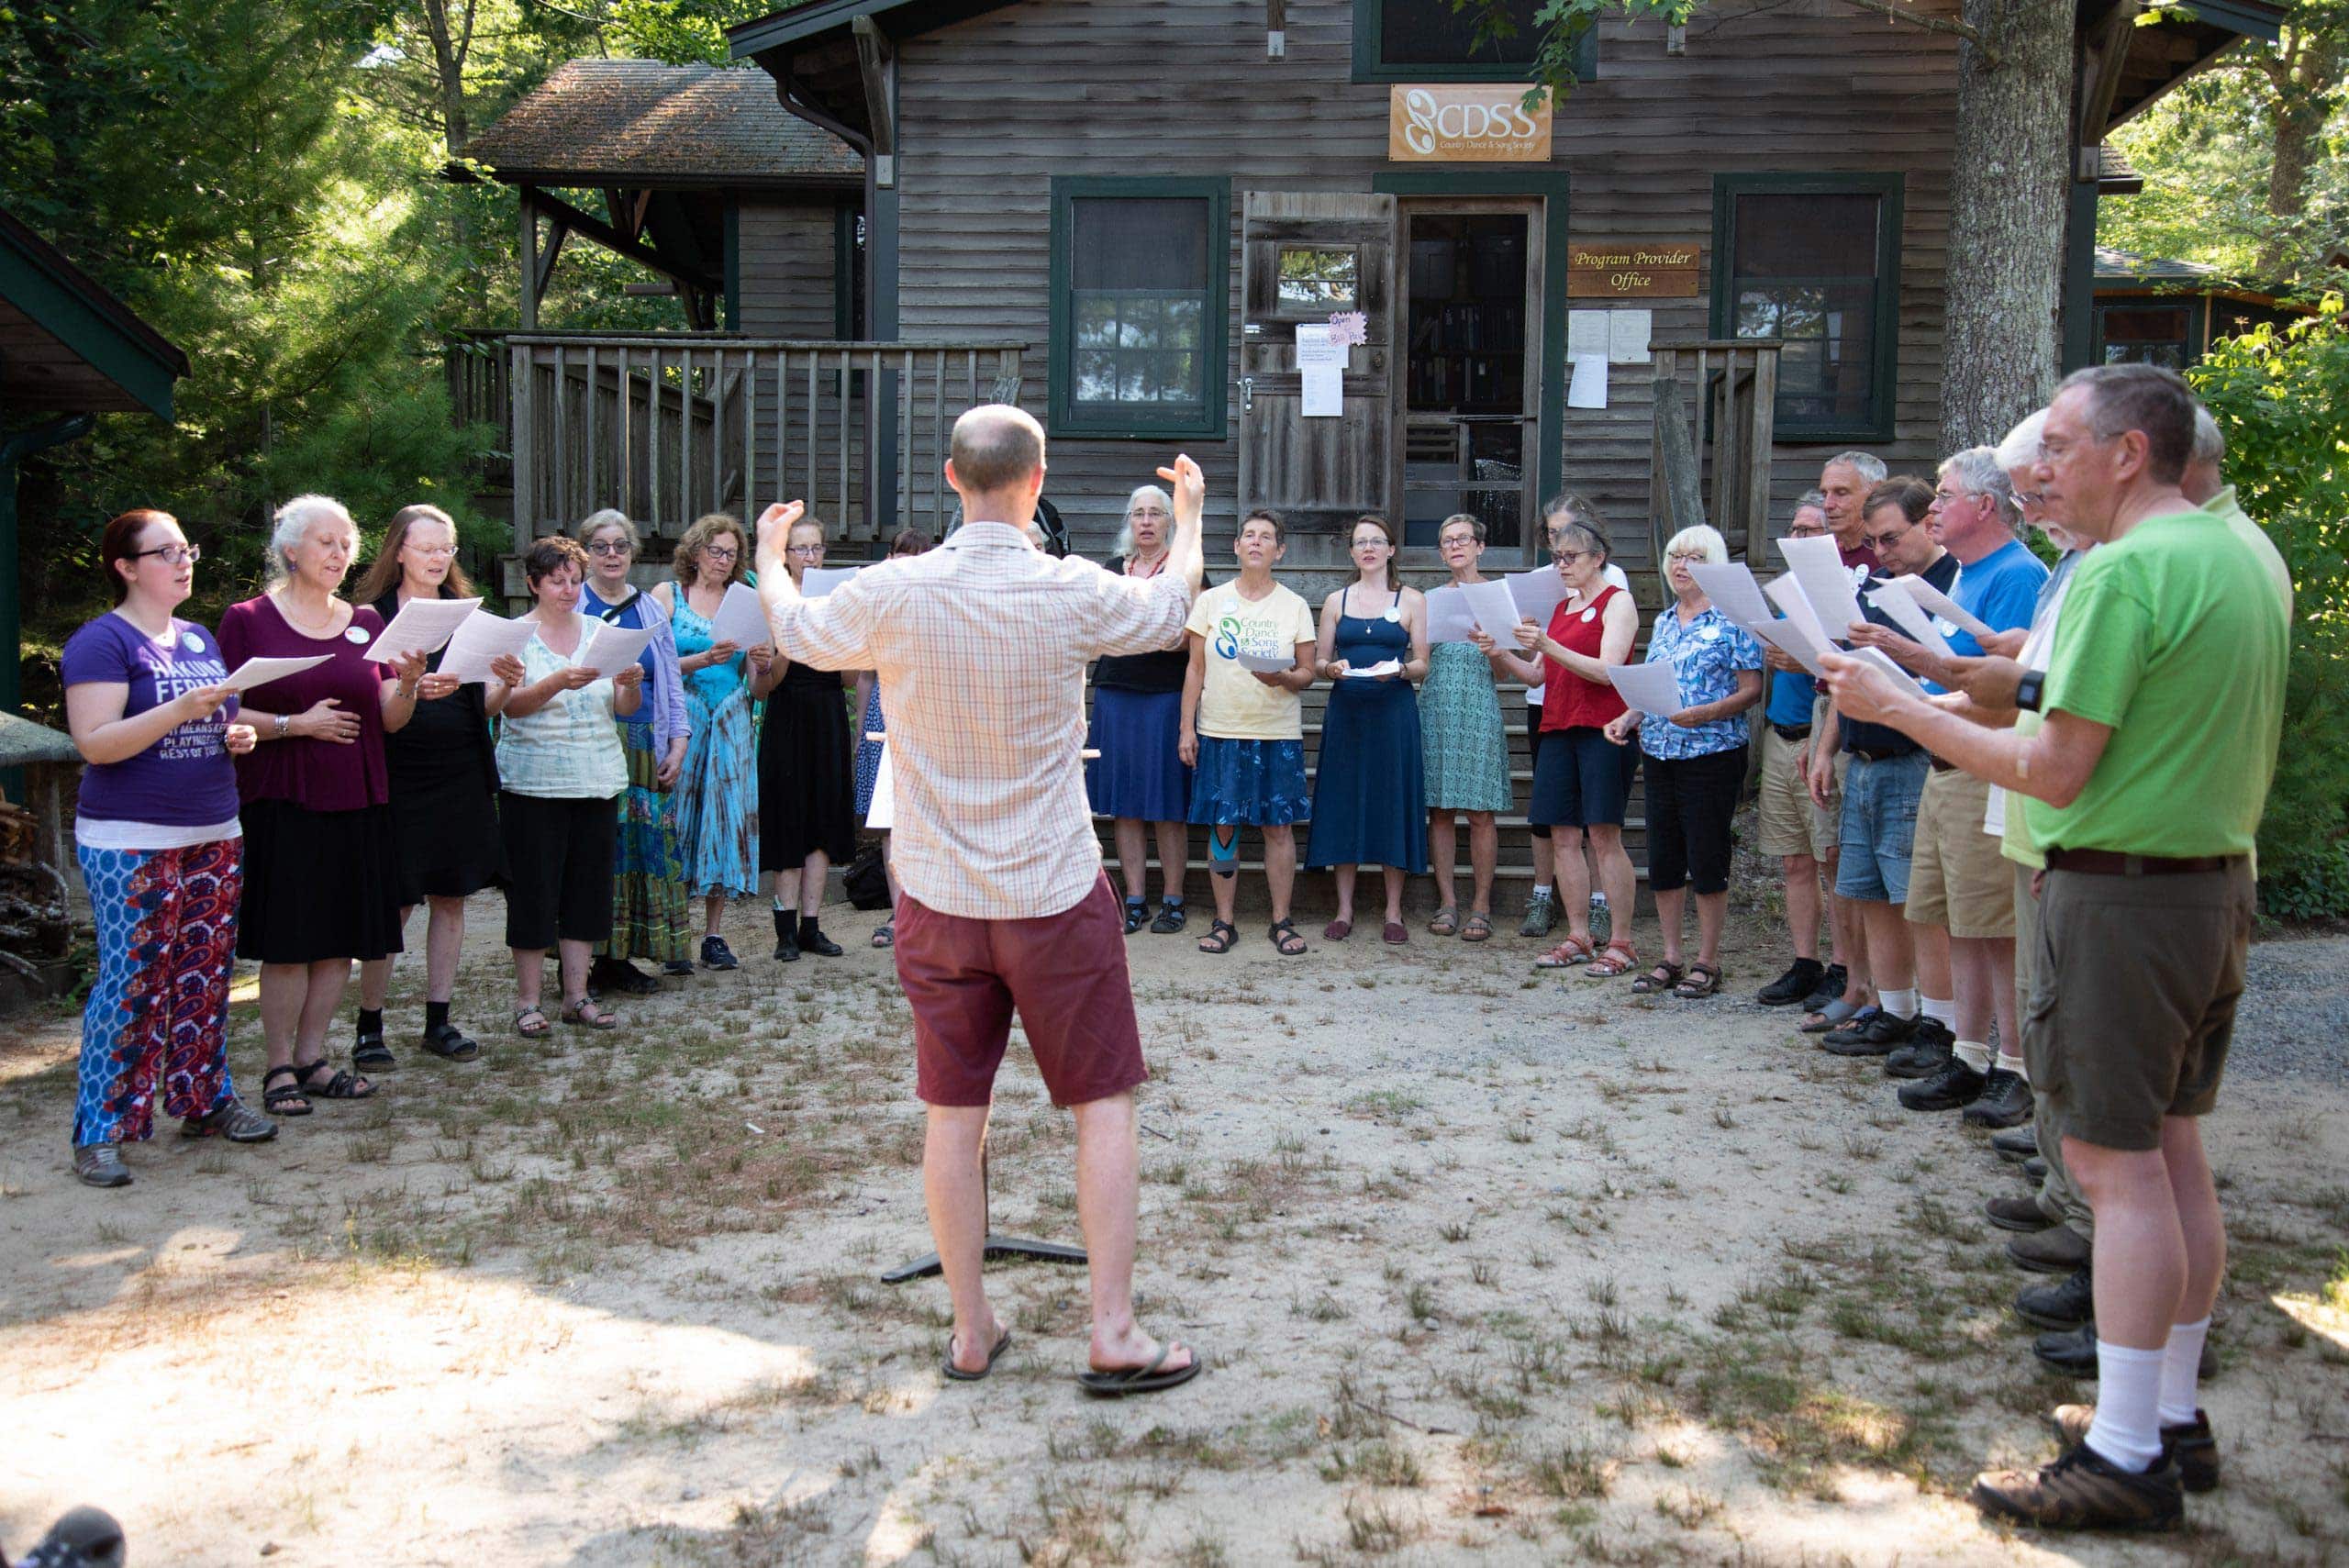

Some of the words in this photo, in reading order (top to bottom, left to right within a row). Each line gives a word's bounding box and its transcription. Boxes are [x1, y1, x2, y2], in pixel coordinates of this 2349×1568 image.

[1438, 103, 1536, 138] CDSS
[1575, 252, 1630, 269] Program
[1633, 250, 1691, 264] Provider
[1611, 272, 1651, 291] Office
[1331, 316, 1351, 327] Open
[1241, 617, 1278, 629] Country
[1246, 628, 1278, 638] Dance
[1252, 638, 1279, 650] Song
[149, 659, 226, 679] HAKUNA
[160, 749, 189, 760] REST
